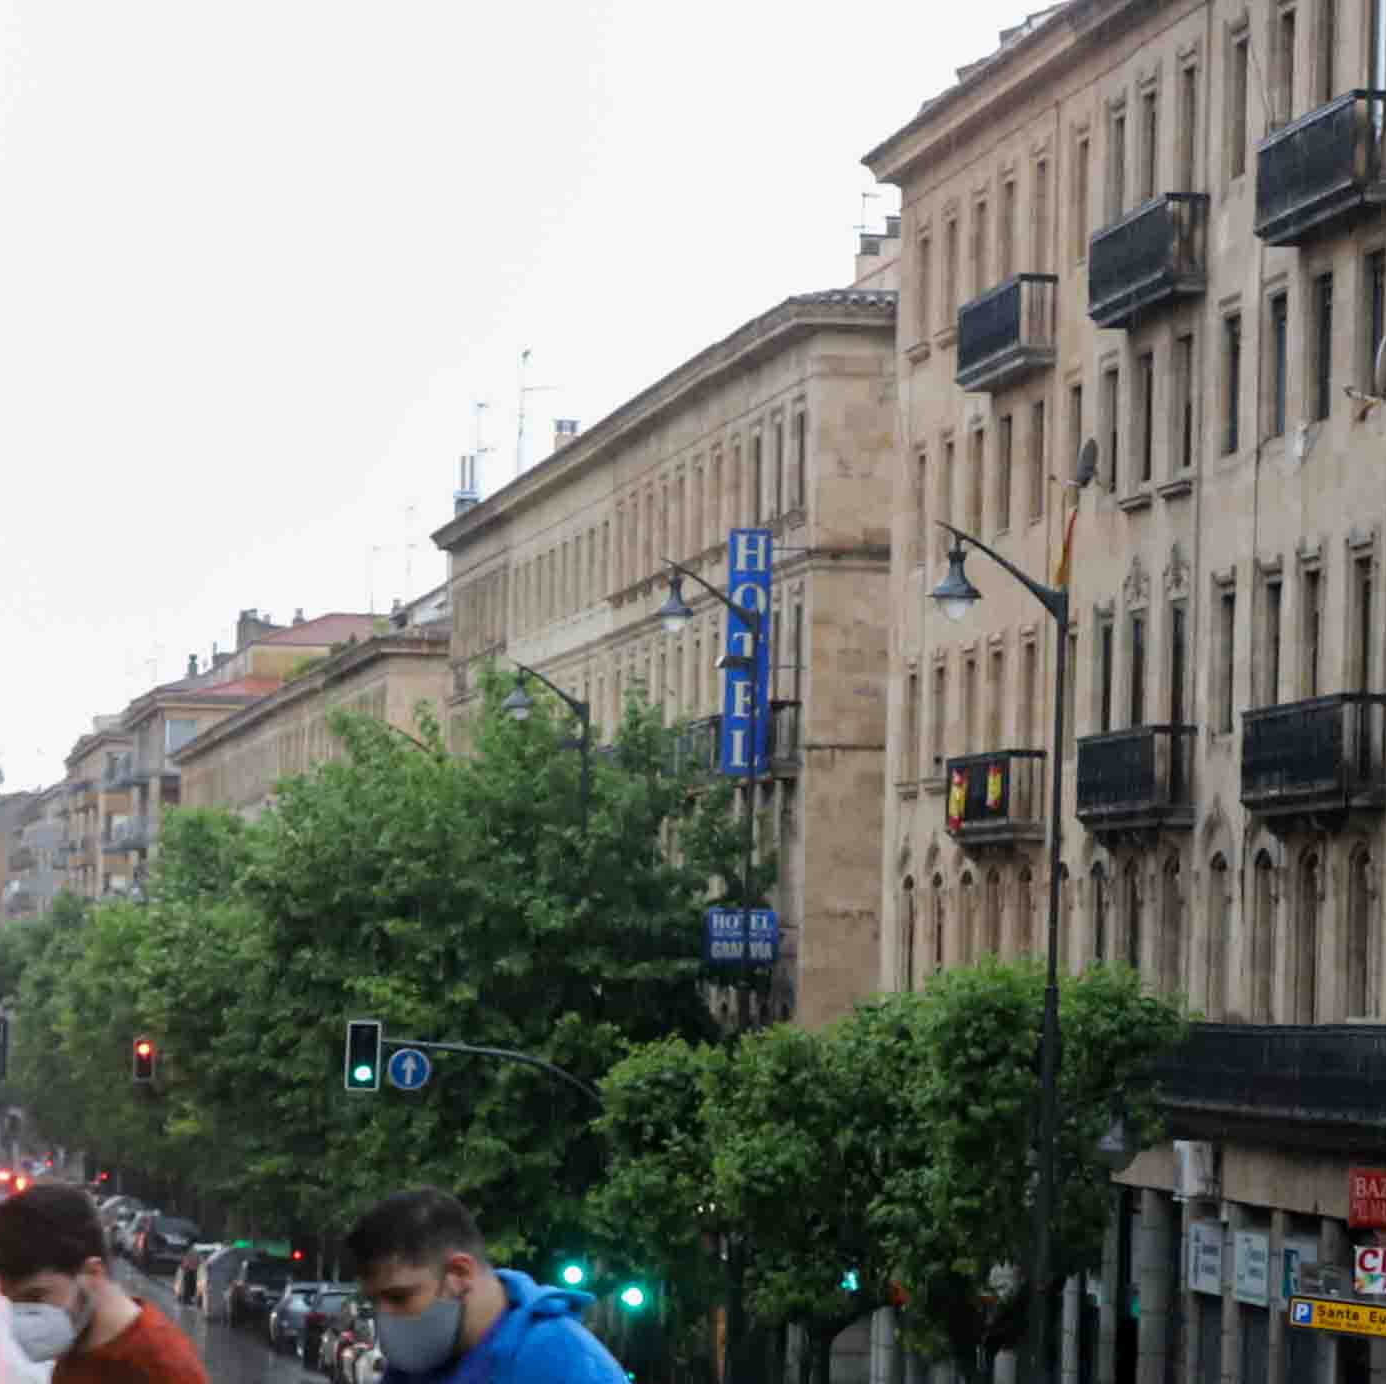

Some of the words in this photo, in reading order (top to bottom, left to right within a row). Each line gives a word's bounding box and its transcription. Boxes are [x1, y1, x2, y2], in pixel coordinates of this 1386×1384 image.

[730, 534, 767, 768] HOTEL
[712, 913, 772, 929] HOEL
[1316, 1303, 1360, 1322] Santa
